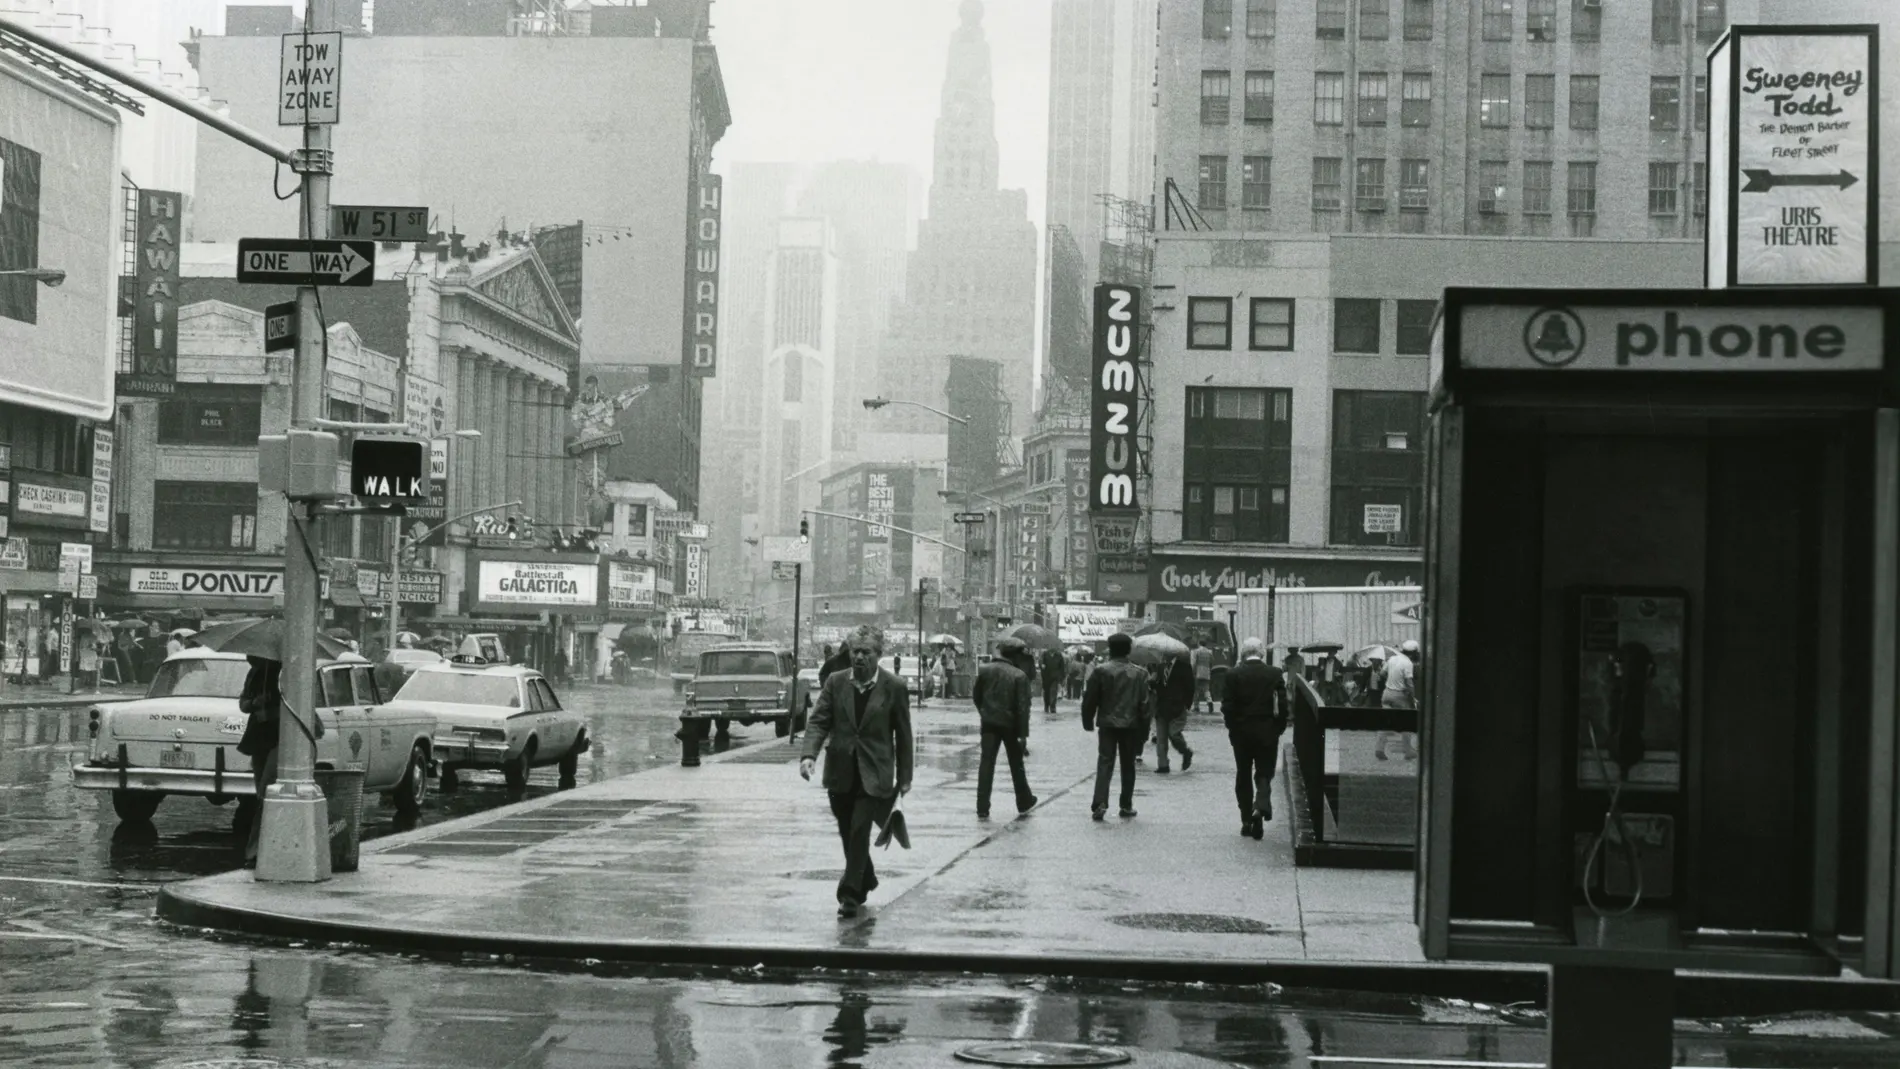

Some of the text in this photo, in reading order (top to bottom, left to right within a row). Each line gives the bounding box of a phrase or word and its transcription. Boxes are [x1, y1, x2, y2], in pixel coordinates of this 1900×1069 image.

[294, 44, 329, 61] TOW
[286, 68, 335, 85] AWAY
[1742, 67, 1863, 96] Sweeney
[284, 92, 333, 110] ZONE
[1764, 93, 1843, 117] Todd
[341, 211, 424, 237] W 51 ST
[1781, 207, 1821, 226] URIS
[1763, 227, 1839, 246] THEATRE
[249, 252, 357, 273] ONE WAY
[146, 195, 174, 350] HAWAII
[692, 186, 719, 368] HOWARD
[268, 315, 286, 338] ONE
[1616, 311, 1847, 365] phone
[363, 475, 422, 497] WALK
[868, 473, 888, 486] THE
[19, 485, 39, 501] CHECK
[40, 488, 67, 504] CASHING
[406, 507, 444, 518] STAURANT
[1071, 464, 1090, 586] TOPLESS
[1094, 524, 1121, 538] Fish
[1098, 538, 1129, 552] Chips
[1022, 516, 1037, 601] STEAKS
[148, 570, 169, 581] OLD
[181, 571, 279, 593] DONUTS
[384, 573, 436, 583] VRSITY
[1160, 564, 1213, 593] Chock
[1209, 566, 1246, 593] full
[136, 580, 179, 592] FASHION
[499, 577, 578, 594] GALACTICA
[383, 592, 436, 602] DNCING
[62, 600, 71, 669] YOGURT
[178, 715, 211, 723] TAILGATE
